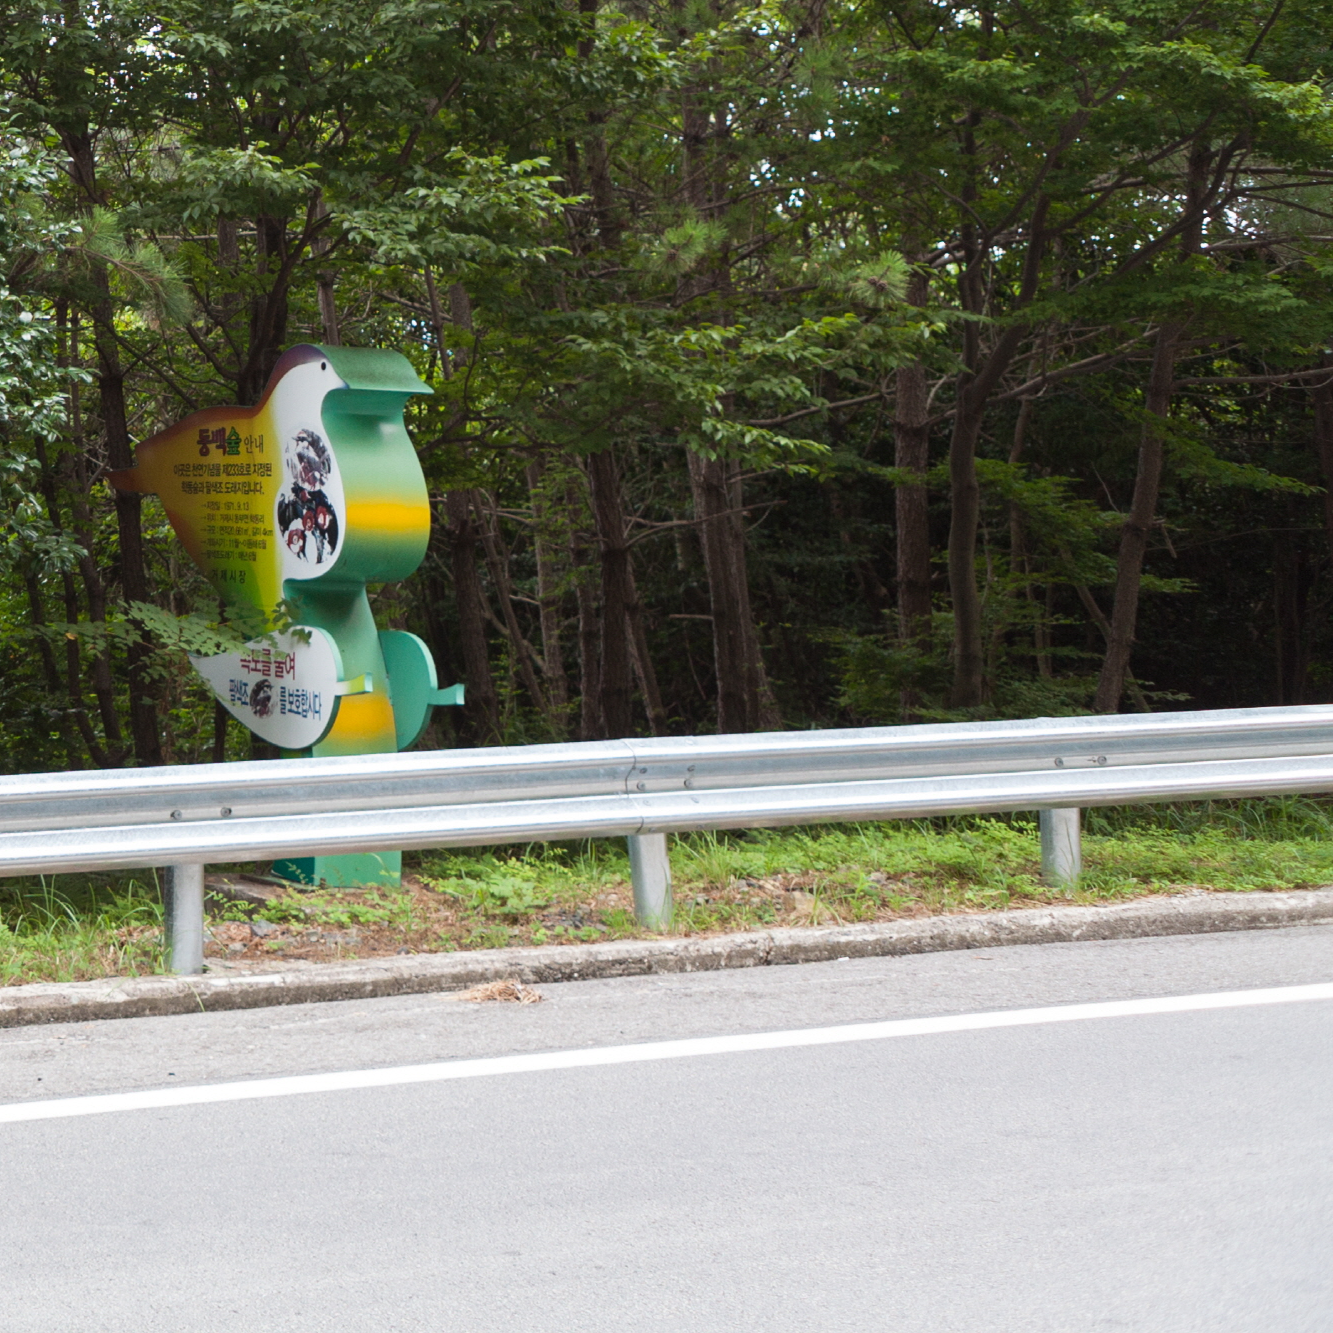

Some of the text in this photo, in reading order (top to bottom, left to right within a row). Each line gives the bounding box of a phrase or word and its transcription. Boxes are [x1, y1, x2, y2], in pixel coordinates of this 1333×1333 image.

[196, 426, 264, 457] 동백숲 안내
[173, 463, 191, 477] 이곳은
[191, 463, 222, 477] 천연기념물
[253, 463, 272, 477] 지정된
[205, 481, 224, 495] 팔색조
[224, 481, 265, 495] 도래지입니다.
[229, 679, 249, 706] 팔색조
